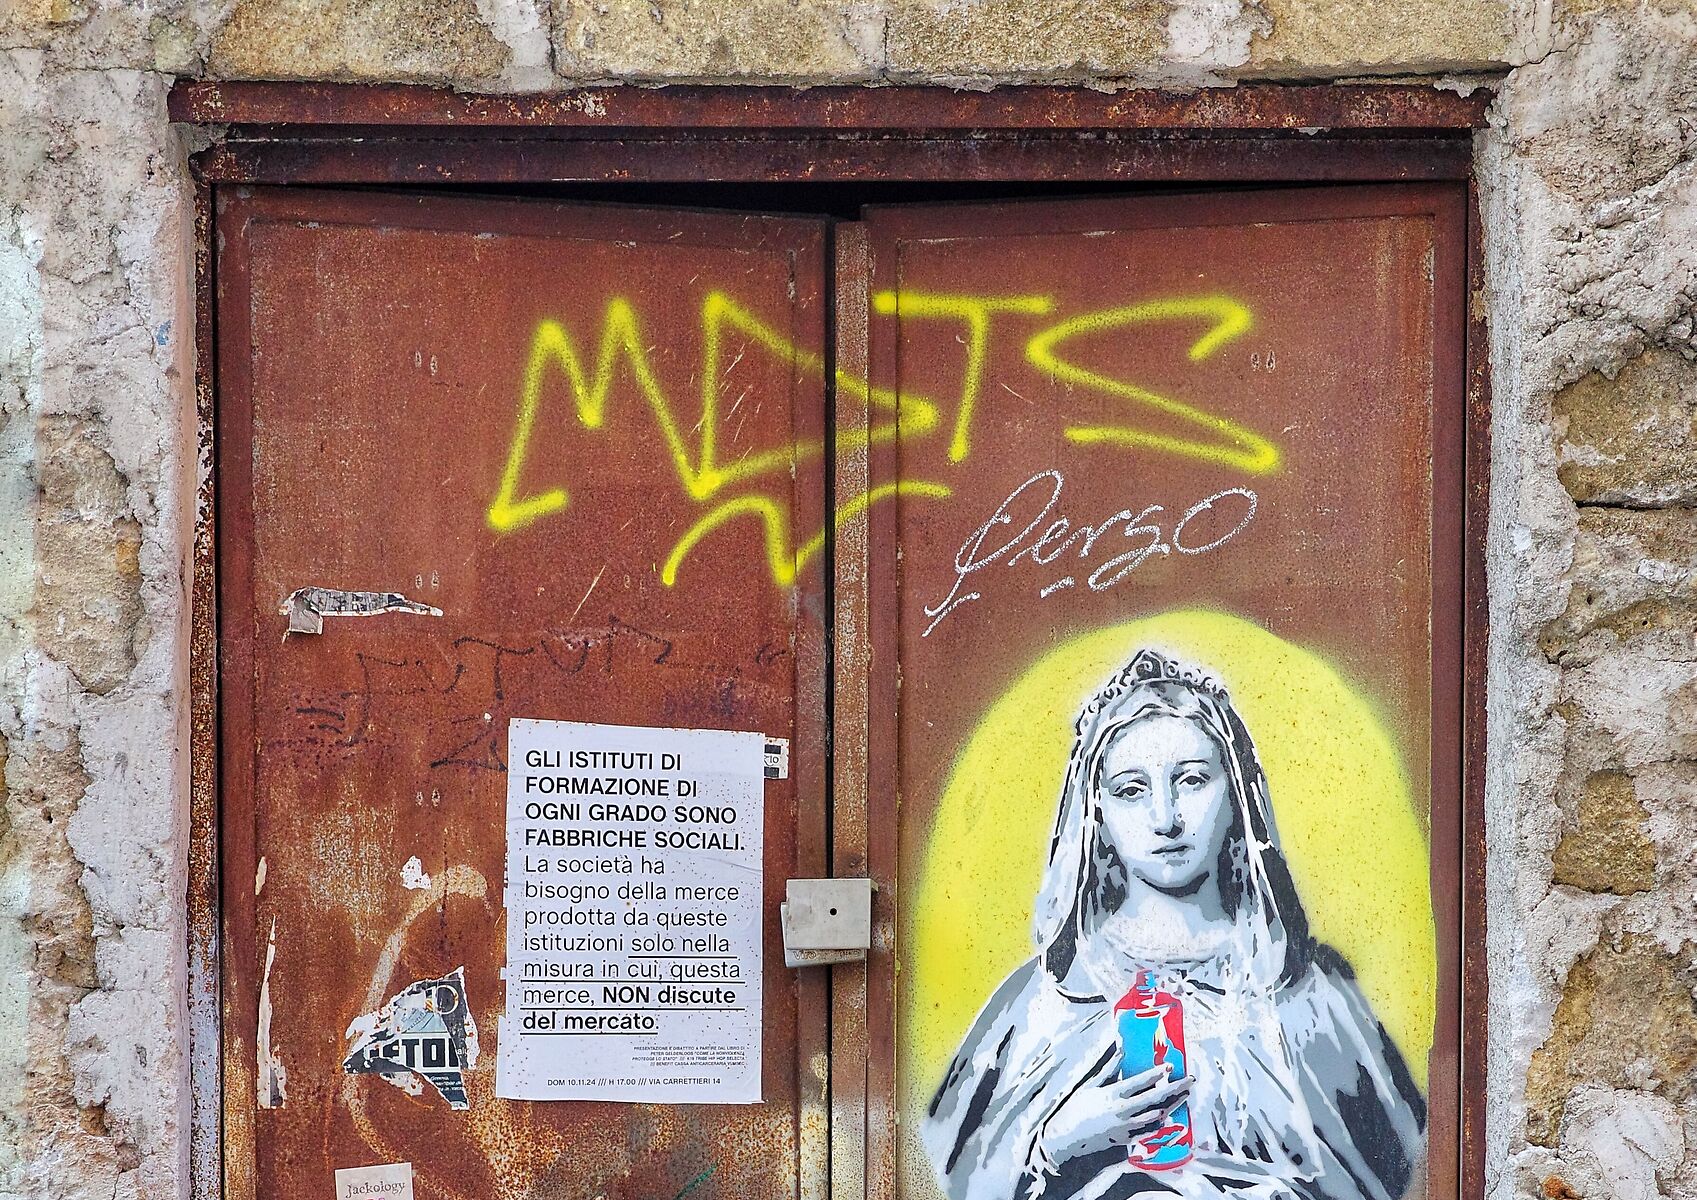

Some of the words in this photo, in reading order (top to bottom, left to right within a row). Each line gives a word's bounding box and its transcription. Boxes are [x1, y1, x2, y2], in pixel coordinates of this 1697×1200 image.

[525, 749, 561, 768] GLI
[569, 750, 653, 770] ISTITUTI
[661, 753, 681, 771] DI
[525, 776, 670, 797] FORMAZIONE
[677, 779, 697, 798] DI
[525, 802, 580, 821] OGNI
[588, 803, 668, 823] GRADO
[674, 805, 737, 825] SONO
[525, 828, 647, 848] FABBRICHE
[654, 831, 745, 851] SOCIALI.
[525, 854, 549, 873] La
[556, 856, 633, 874] società
[641, 856, 665, 875] ha
[525, 880, 610, 904] bisogno
[617, 880, 667, 900] della
[675, 886, 739, 901] merce
[524, 907, 615, 930] prodotta
[623, 908, 649, 926] da
[656, 909, 728, 931] queste
[523, 934, 623, 952] istituzioni
[631, 934, 674, 952] solo
[680, 934, 730, 953] nella
[524, 962, 594, 978] misura
[602, 963, 619, 978] in
[627, 962, 663, 981] cui,
[670, 961, 740, 982] questa
[523, 989, 595, 1007] merce,
[603, 985, 650, 1004] NON
[657, 985, 736, 1004] discute
[522, 1011, 557, 1030] del
[564, 1013, 659, 1030] mercato.
[617, 1078, 636, 1086] 17.00
